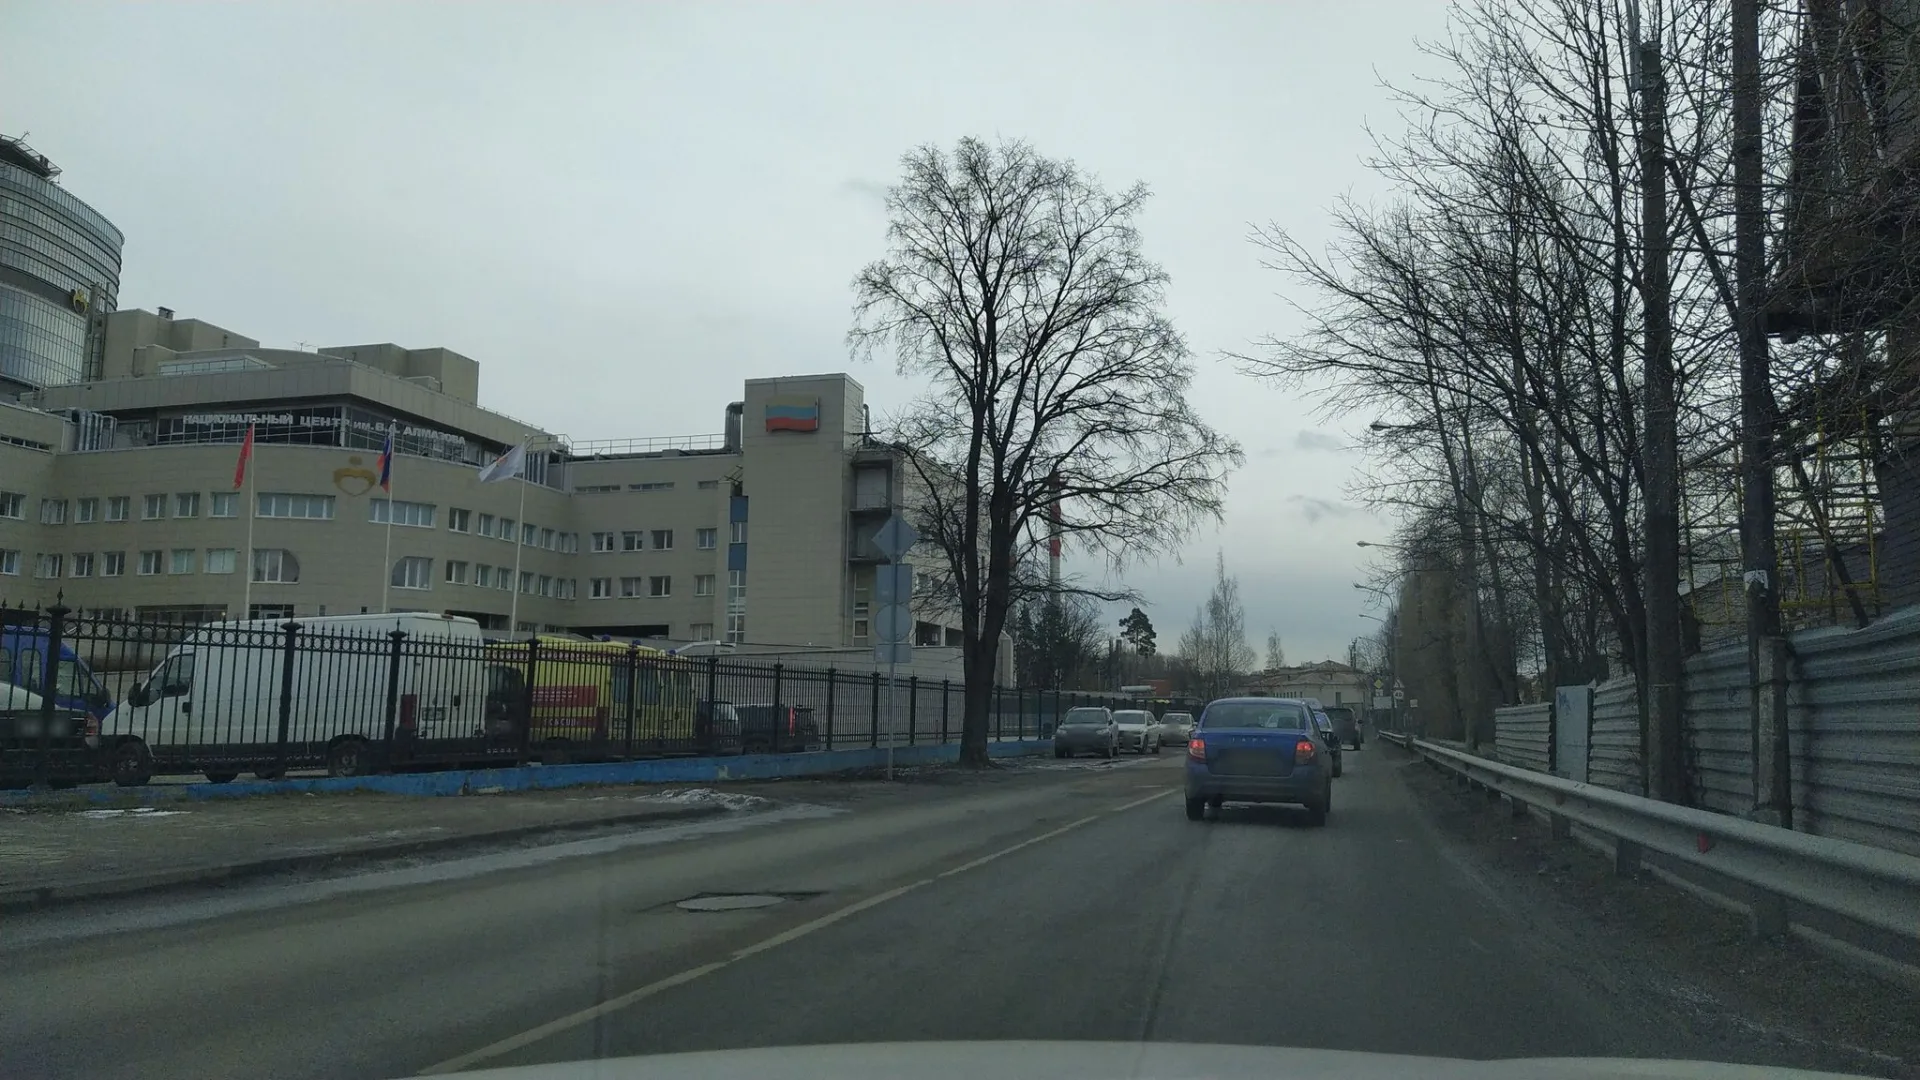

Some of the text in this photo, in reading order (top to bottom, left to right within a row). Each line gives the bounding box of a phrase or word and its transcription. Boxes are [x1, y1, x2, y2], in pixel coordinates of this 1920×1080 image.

[183, 413, 293, 425] НАЦИОНАЛЬНЫЙ
[300, 415, 351, 428] ЦЕНТР
[403, 426, 466, 446] АЛМАЗОВА
